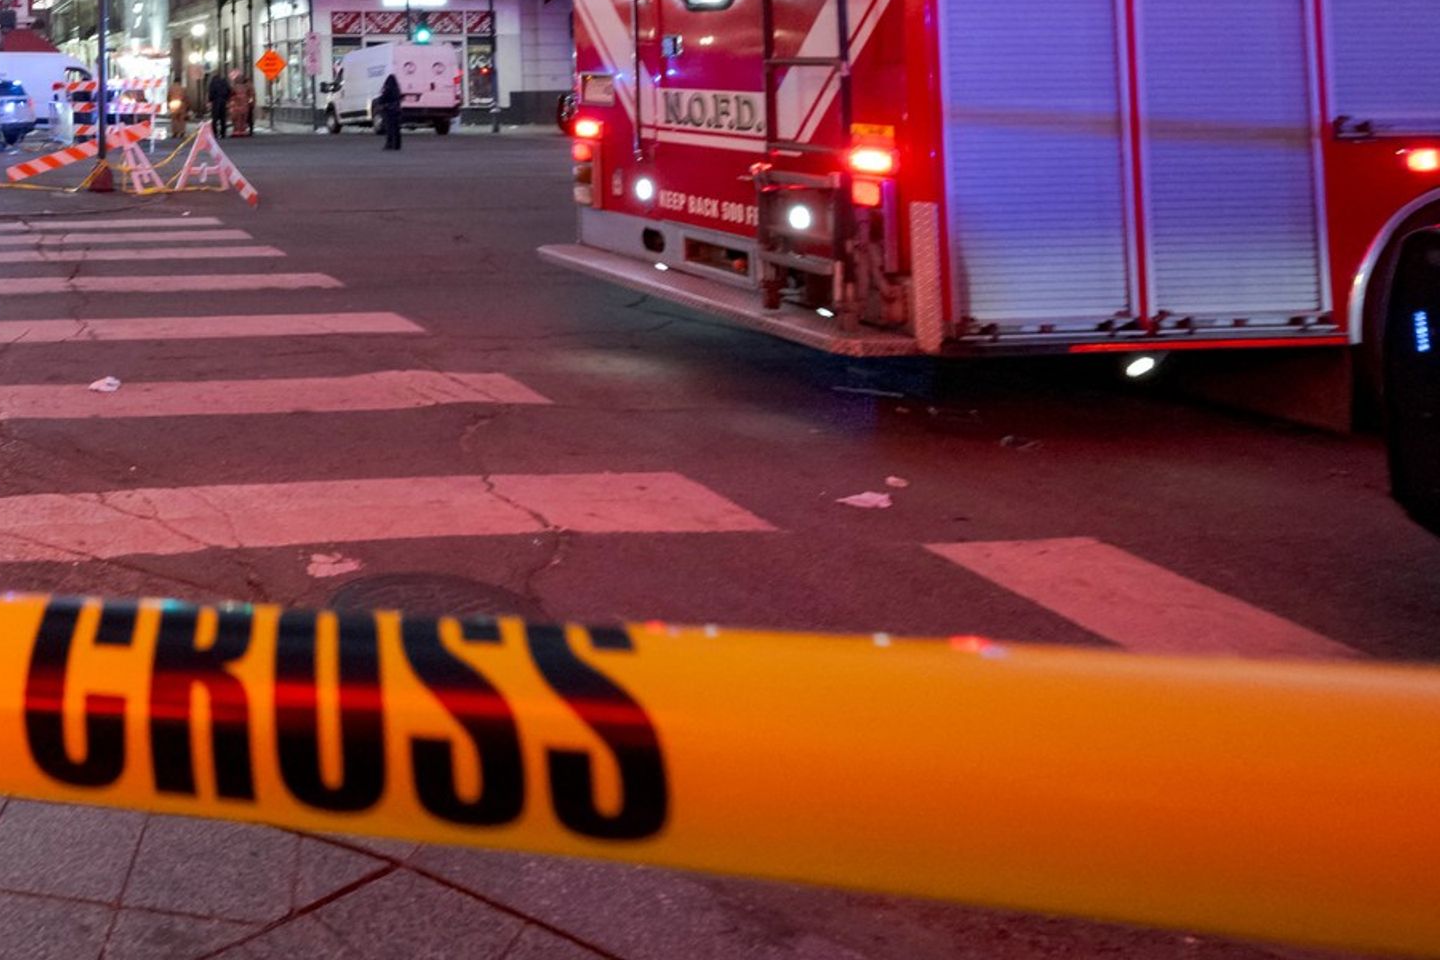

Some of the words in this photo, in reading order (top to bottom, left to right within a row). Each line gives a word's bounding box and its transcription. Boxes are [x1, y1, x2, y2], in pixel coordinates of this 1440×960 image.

[663, 90, 764, 133] N.O.F.D.
[688, 194, 719, 219] BACK
[22, 597, 670, 841] CROSS
